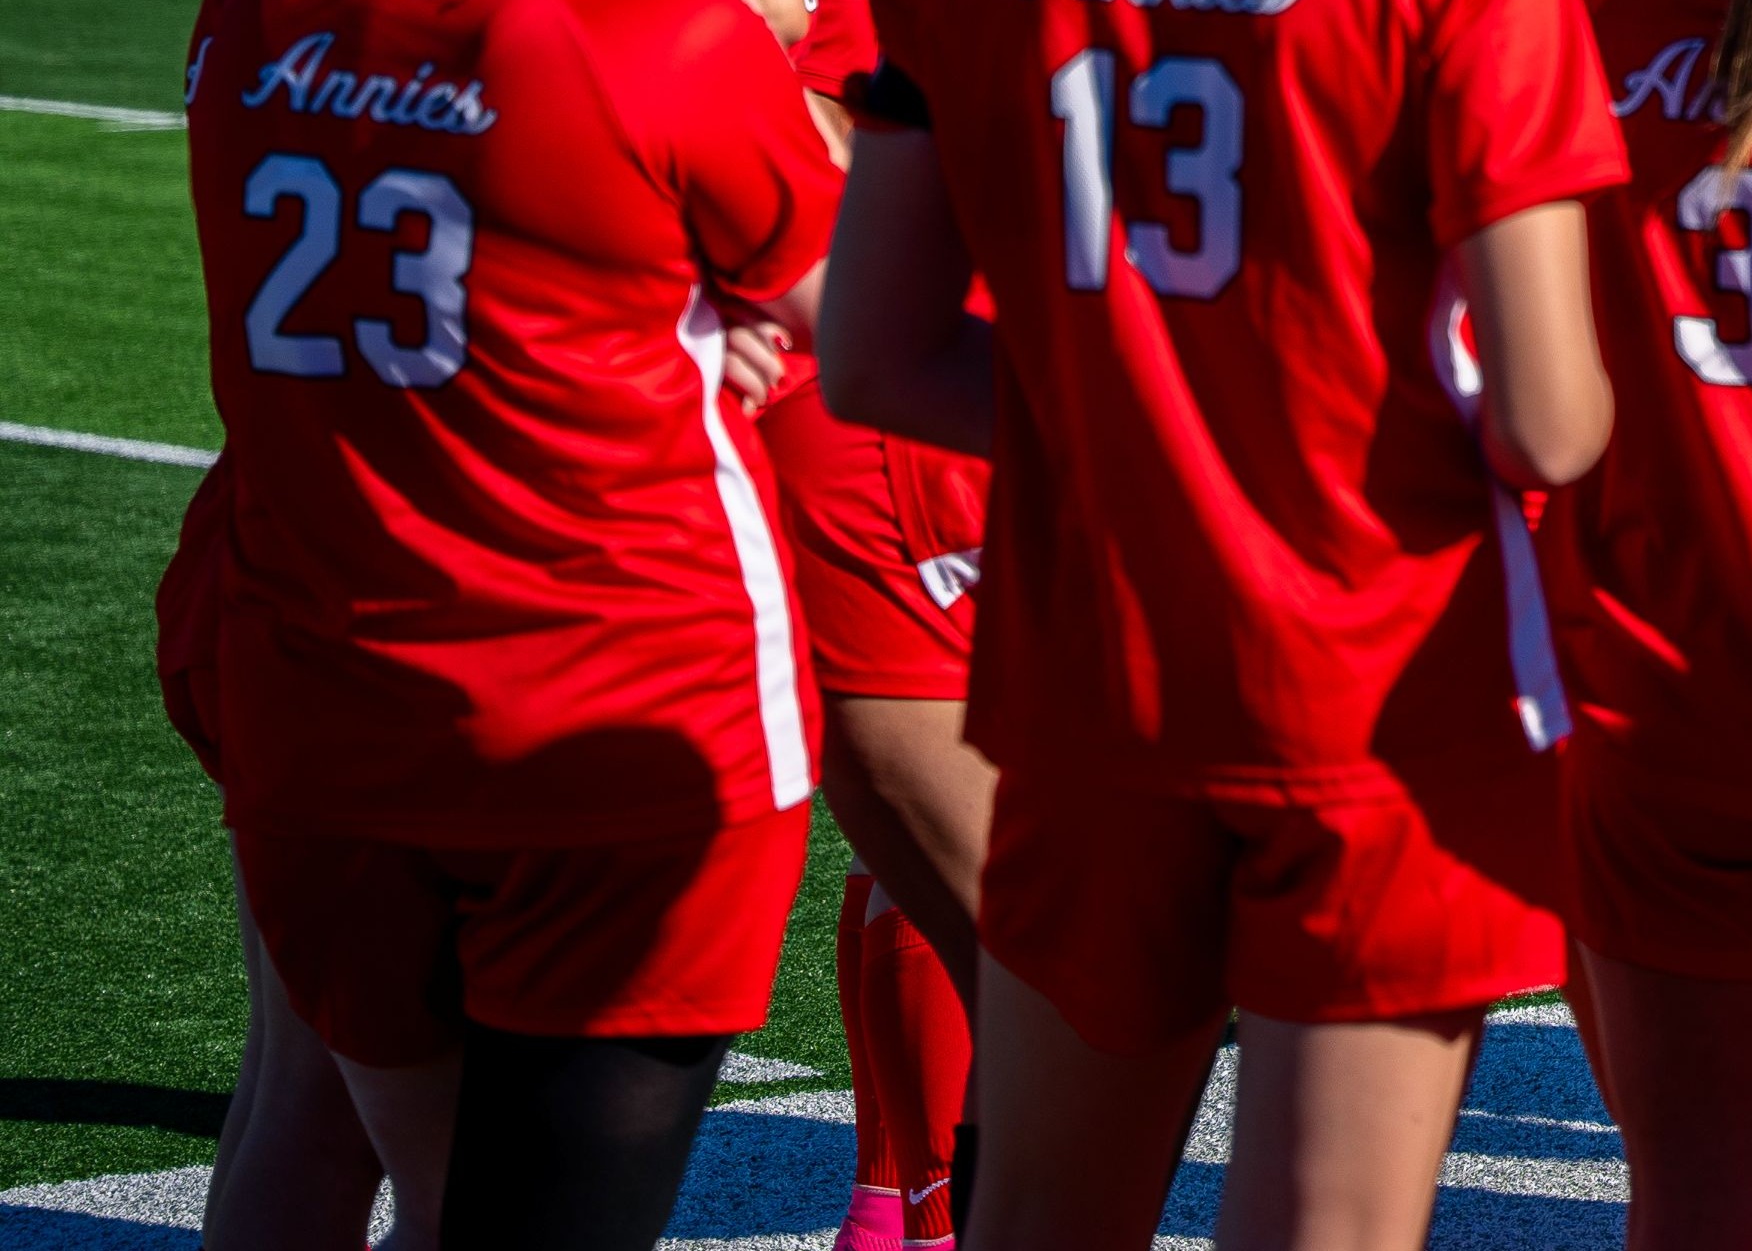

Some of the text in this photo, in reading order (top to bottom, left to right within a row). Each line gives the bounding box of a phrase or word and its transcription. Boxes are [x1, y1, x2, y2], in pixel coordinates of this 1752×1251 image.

[241, 31, 498, 135] Annies
[1051, 49, 1244, 299] 13
[243, 152, 474, 390] 23
